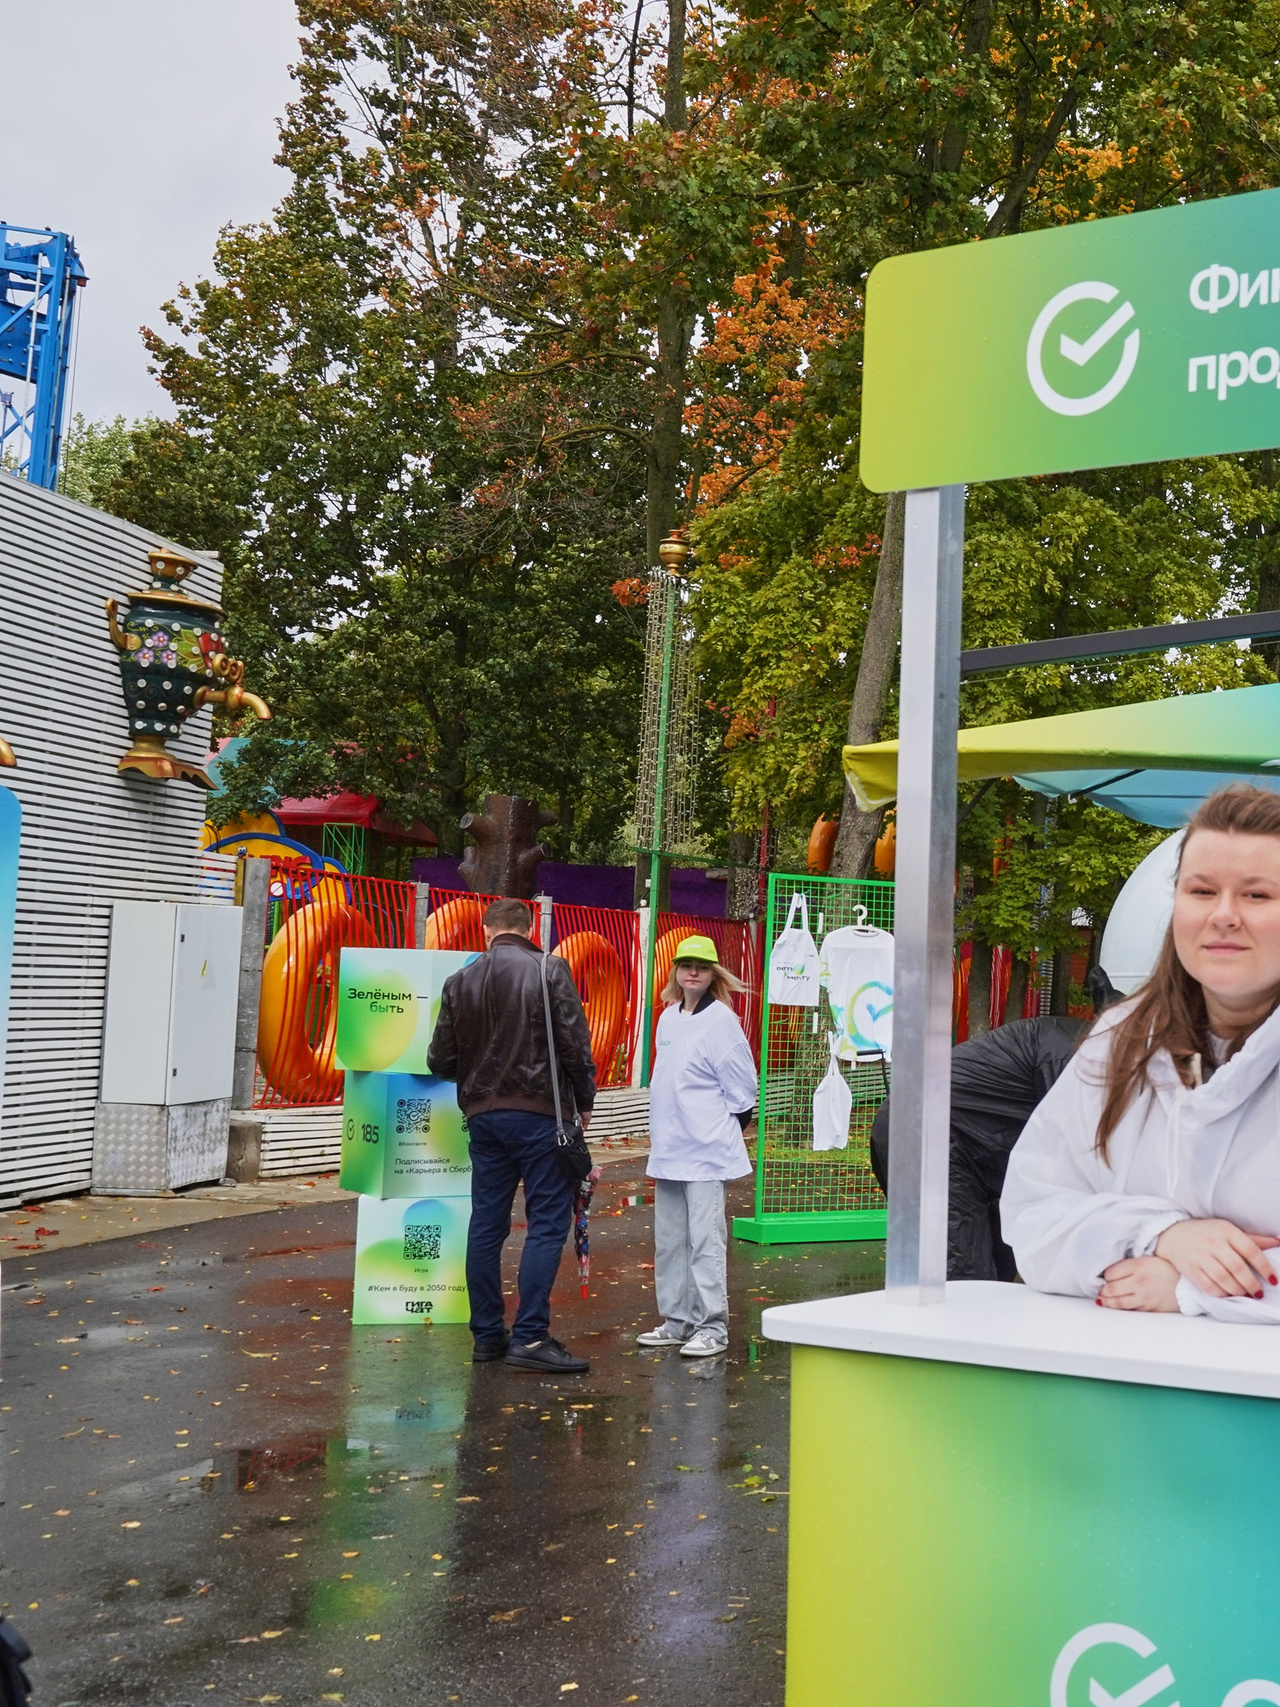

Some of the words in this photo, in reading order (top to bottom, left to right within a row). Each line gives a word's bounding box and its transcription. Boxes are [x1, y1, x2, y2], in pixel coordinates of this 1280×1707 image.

[347, 988, 412, 1001] Зелёным
[369, 1001, 404, 1013] быть
[361, 1123, 379, 1144] 185
[394, 1156, 450, 1165] Подписывайся
[448, 1164, 472, 1174] Сберб
[367, 1284, 390, 1292] #Кем
[399, 1284, 418, 1292] буду
[426, 1284, 446, 1292] 2050
